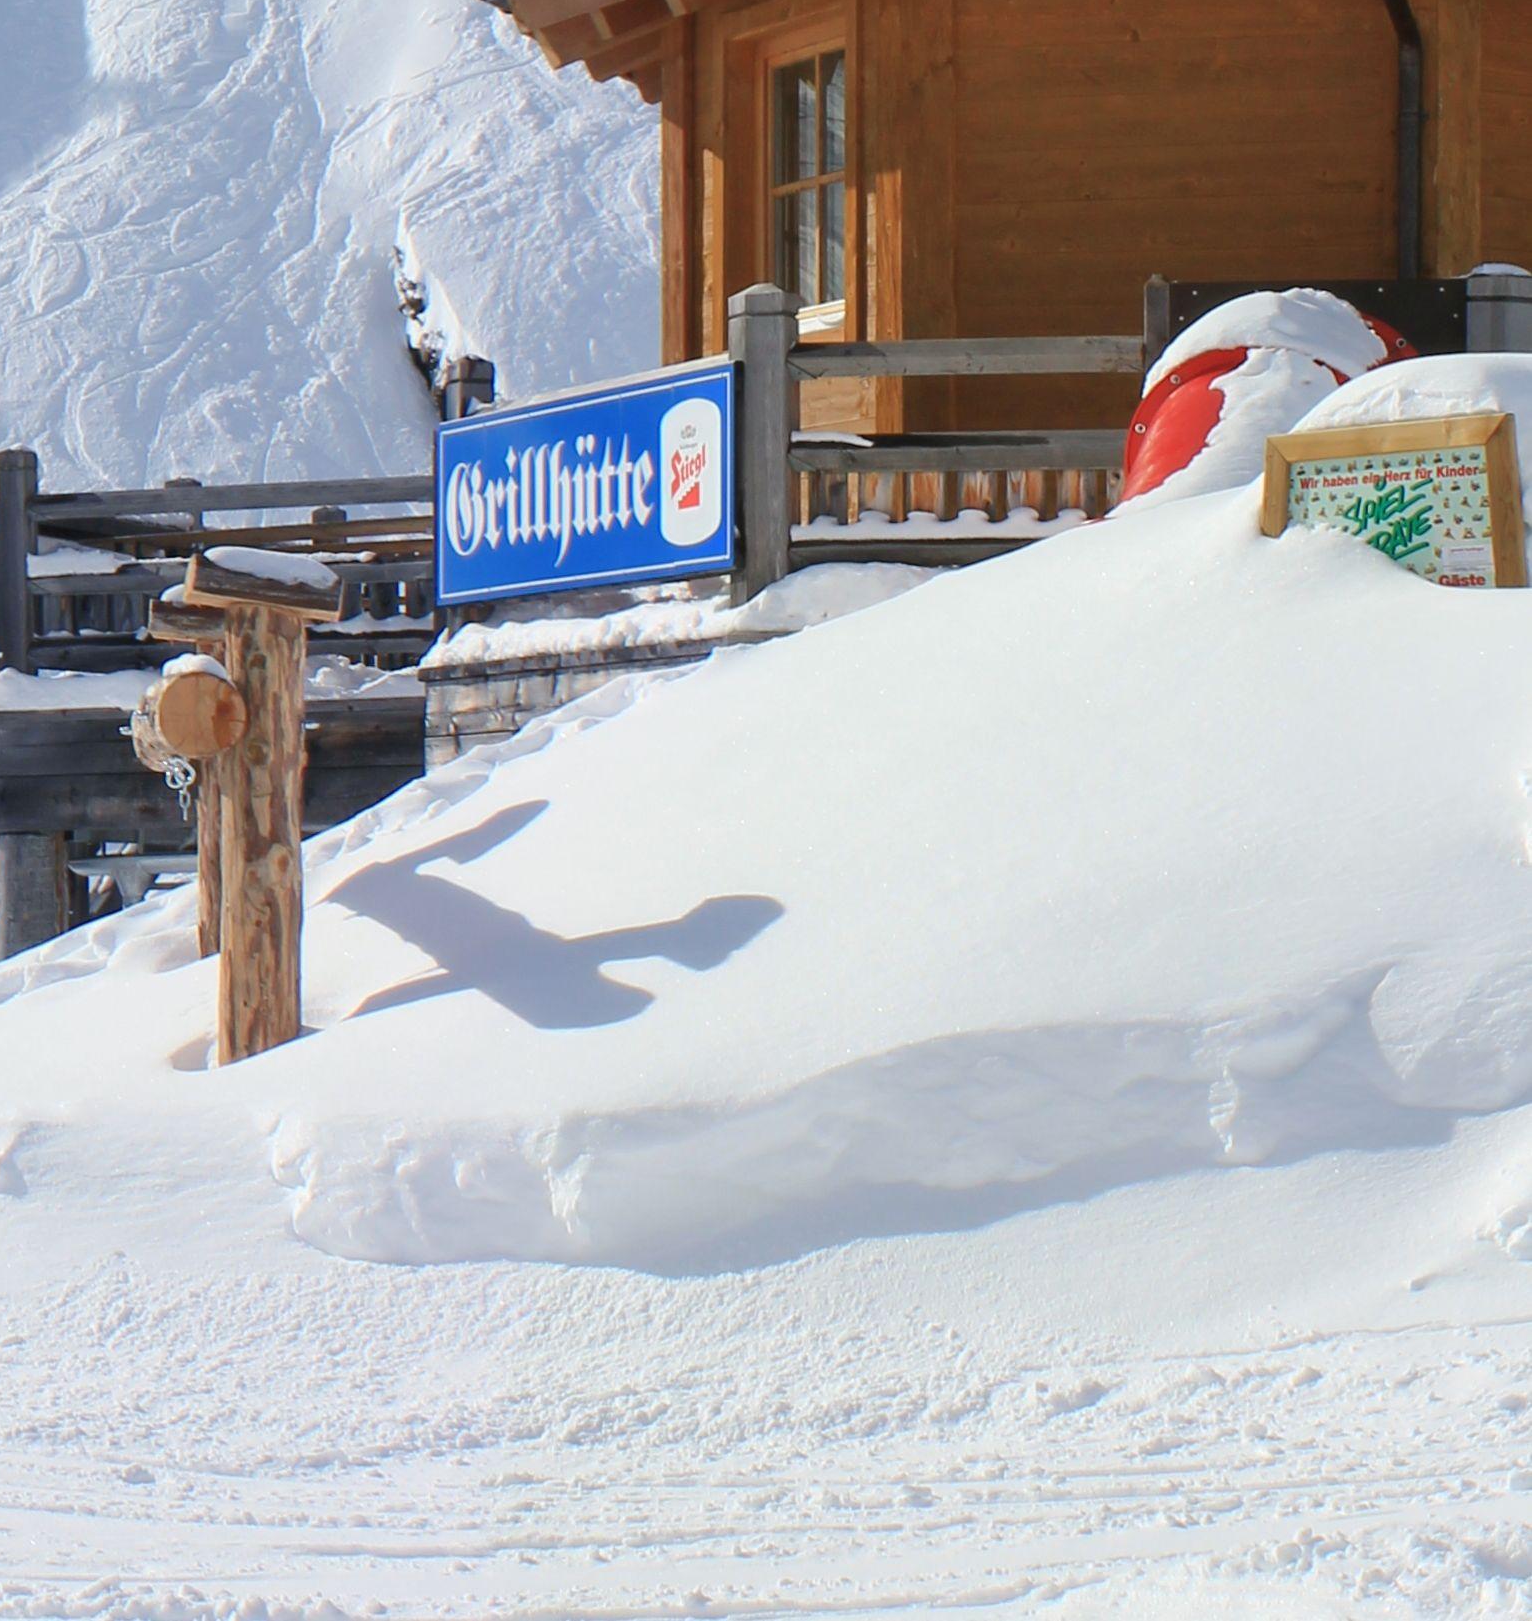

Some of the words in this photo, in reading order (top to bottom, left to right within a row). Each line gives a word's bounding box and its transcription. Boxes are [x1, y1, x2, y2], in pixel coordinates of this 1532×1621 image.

[671, 443, 706, 499] Stiegl
[1300, 478, 1318, 490] Wir
[1322, 474, 1358, 487] haben
[1385, 470, 1411, 482] Herz
[1415, 467, 1433, 480] für
[1436, 465, 1479, 478] Kinder
[446, 433, 654, 568] Grillhütte
[1439, 574, 1485, 586] Gäste
